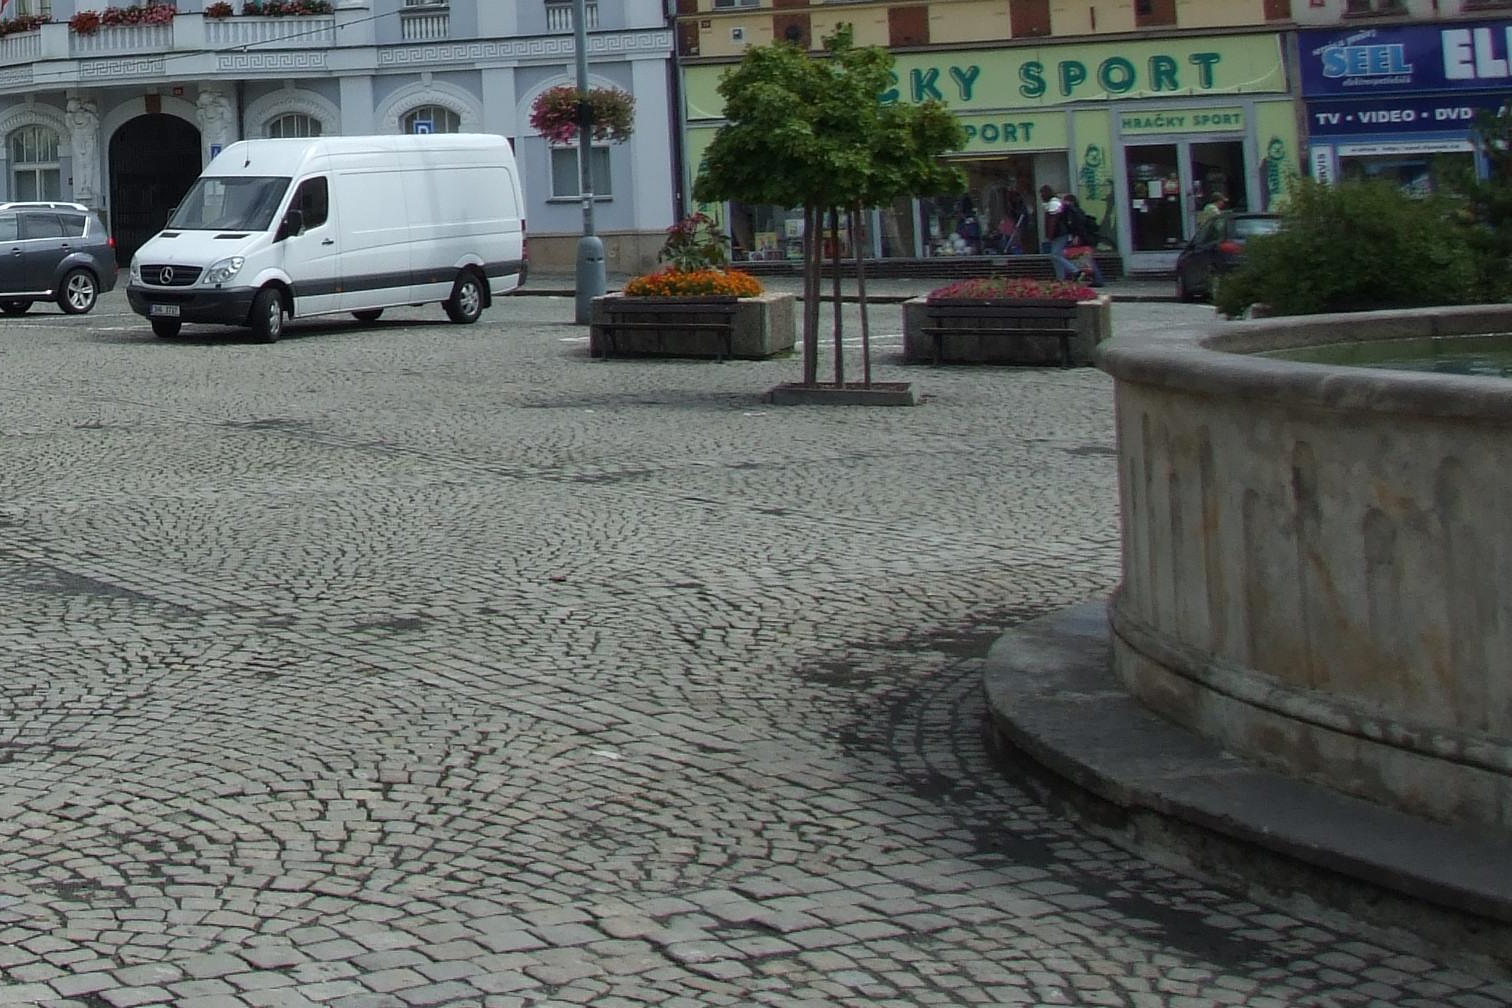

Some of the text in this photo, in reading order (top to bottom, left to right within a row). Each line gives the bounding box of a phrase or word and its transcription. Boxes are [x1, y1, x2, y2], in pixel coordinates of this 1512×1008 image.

[1321, 43, 1414, 78] SEEL
[1441, 26, 1512, 80] EL
[1018, 52, 1221, 99] SPORT
[1122, 113, 1241, 129] HRAČKY SPORT
[1316, 107, 1473, 125] TV VIDEO DVD
